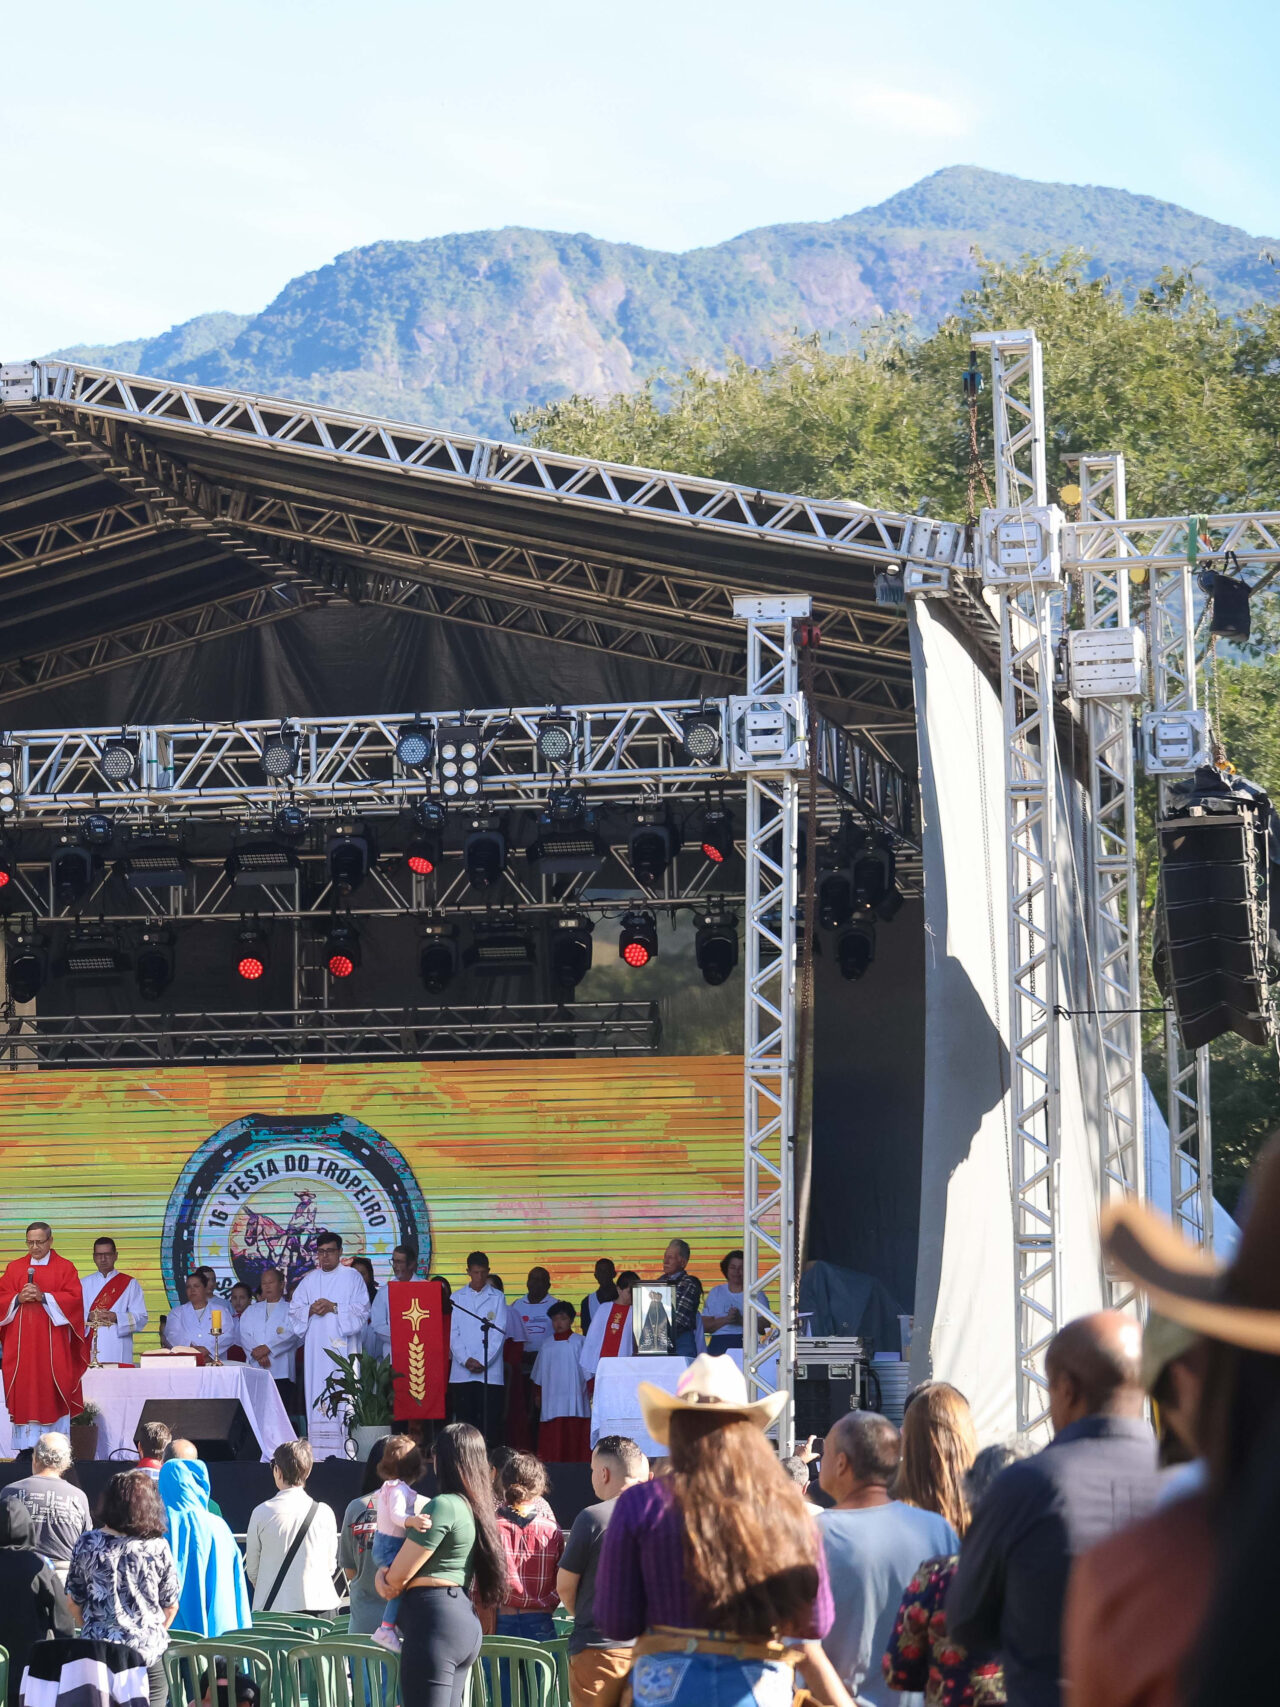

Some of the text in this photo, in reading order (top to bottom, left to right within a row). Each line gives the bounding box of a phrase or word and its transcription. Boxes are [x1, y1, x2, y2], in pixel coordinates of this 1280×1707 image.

[225, 1158, 280, 1201] FESTA
[284, 1154, 309, 1172] DO
[316, 1157, 387, 1227] TROPEIRO
